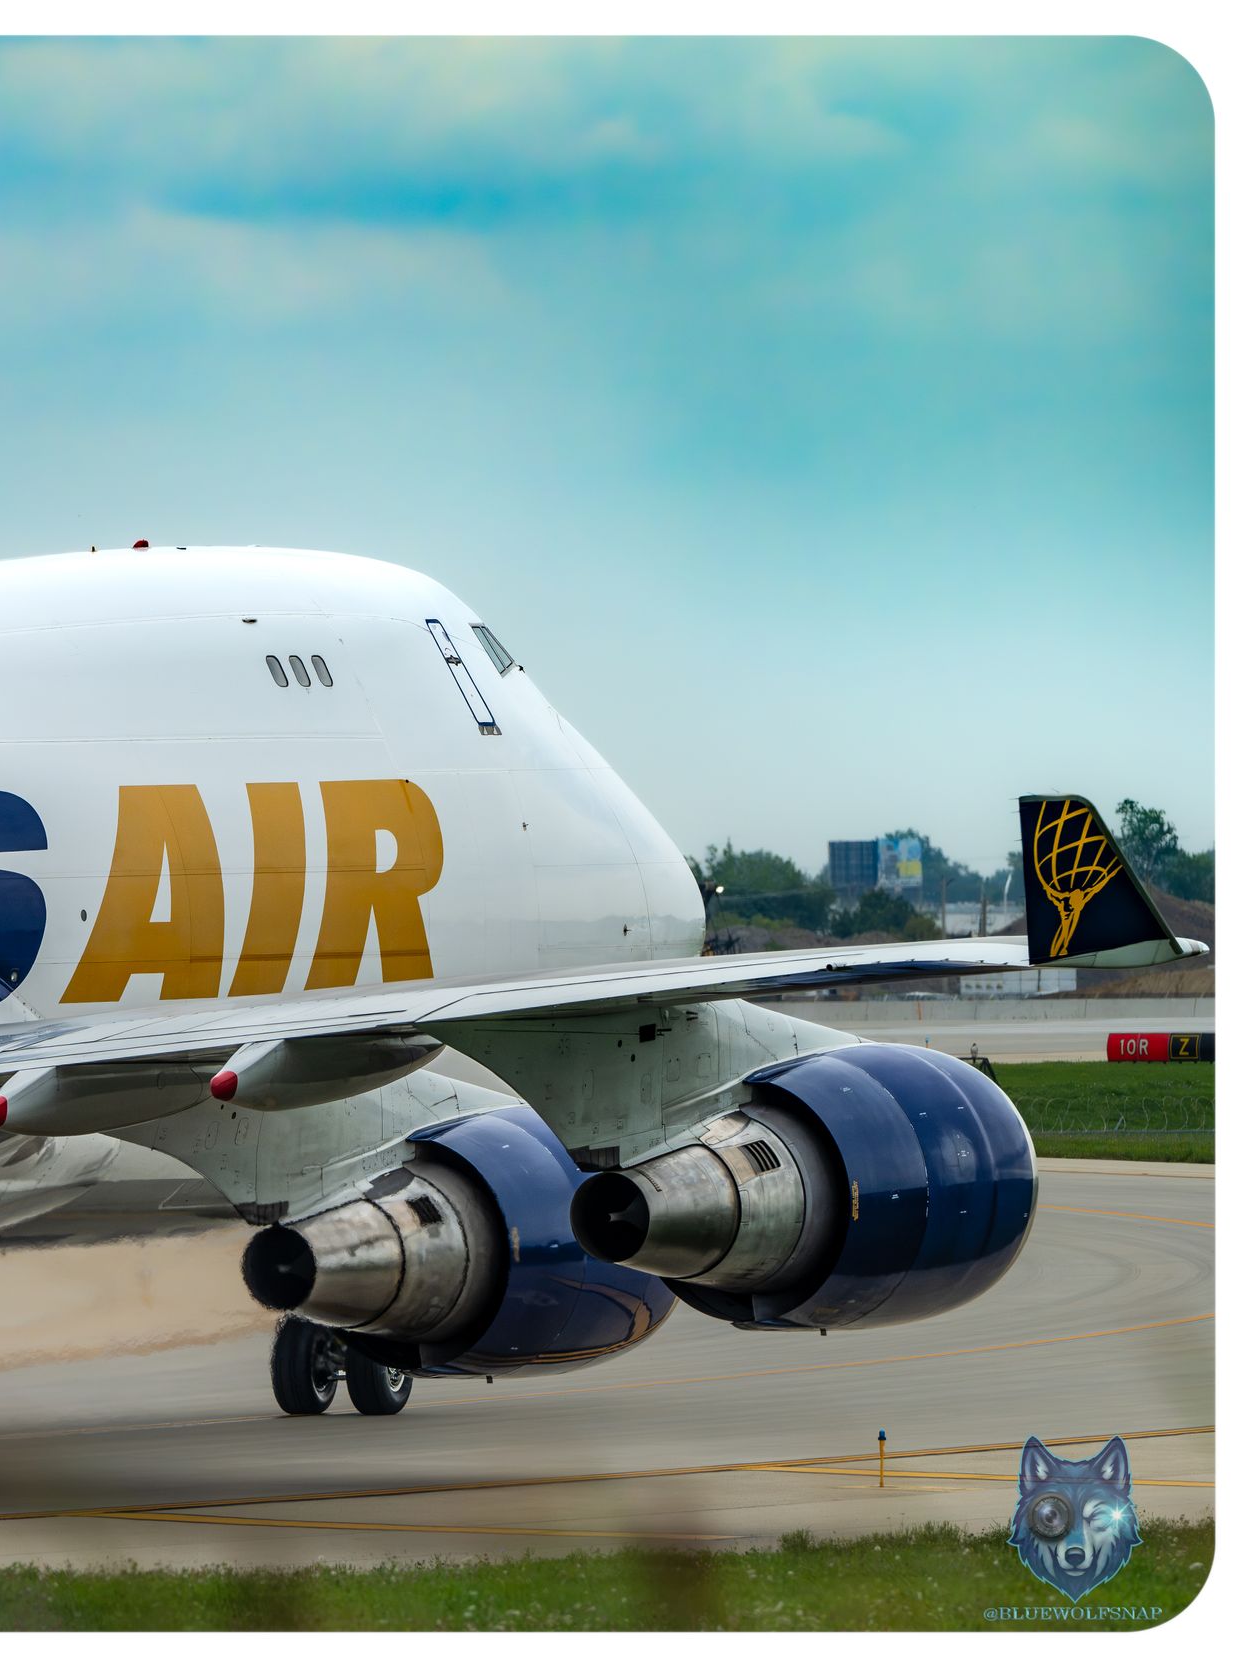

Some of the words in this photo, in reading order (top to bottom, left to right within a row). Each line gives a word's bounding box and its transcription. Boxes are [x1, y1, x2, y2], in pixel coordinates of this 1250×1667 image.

[59, 778, 445, 1005] AIR
[1120, 1039, 1148, 1055] 10R
[1179, 1038, 1189, 1055] Z
